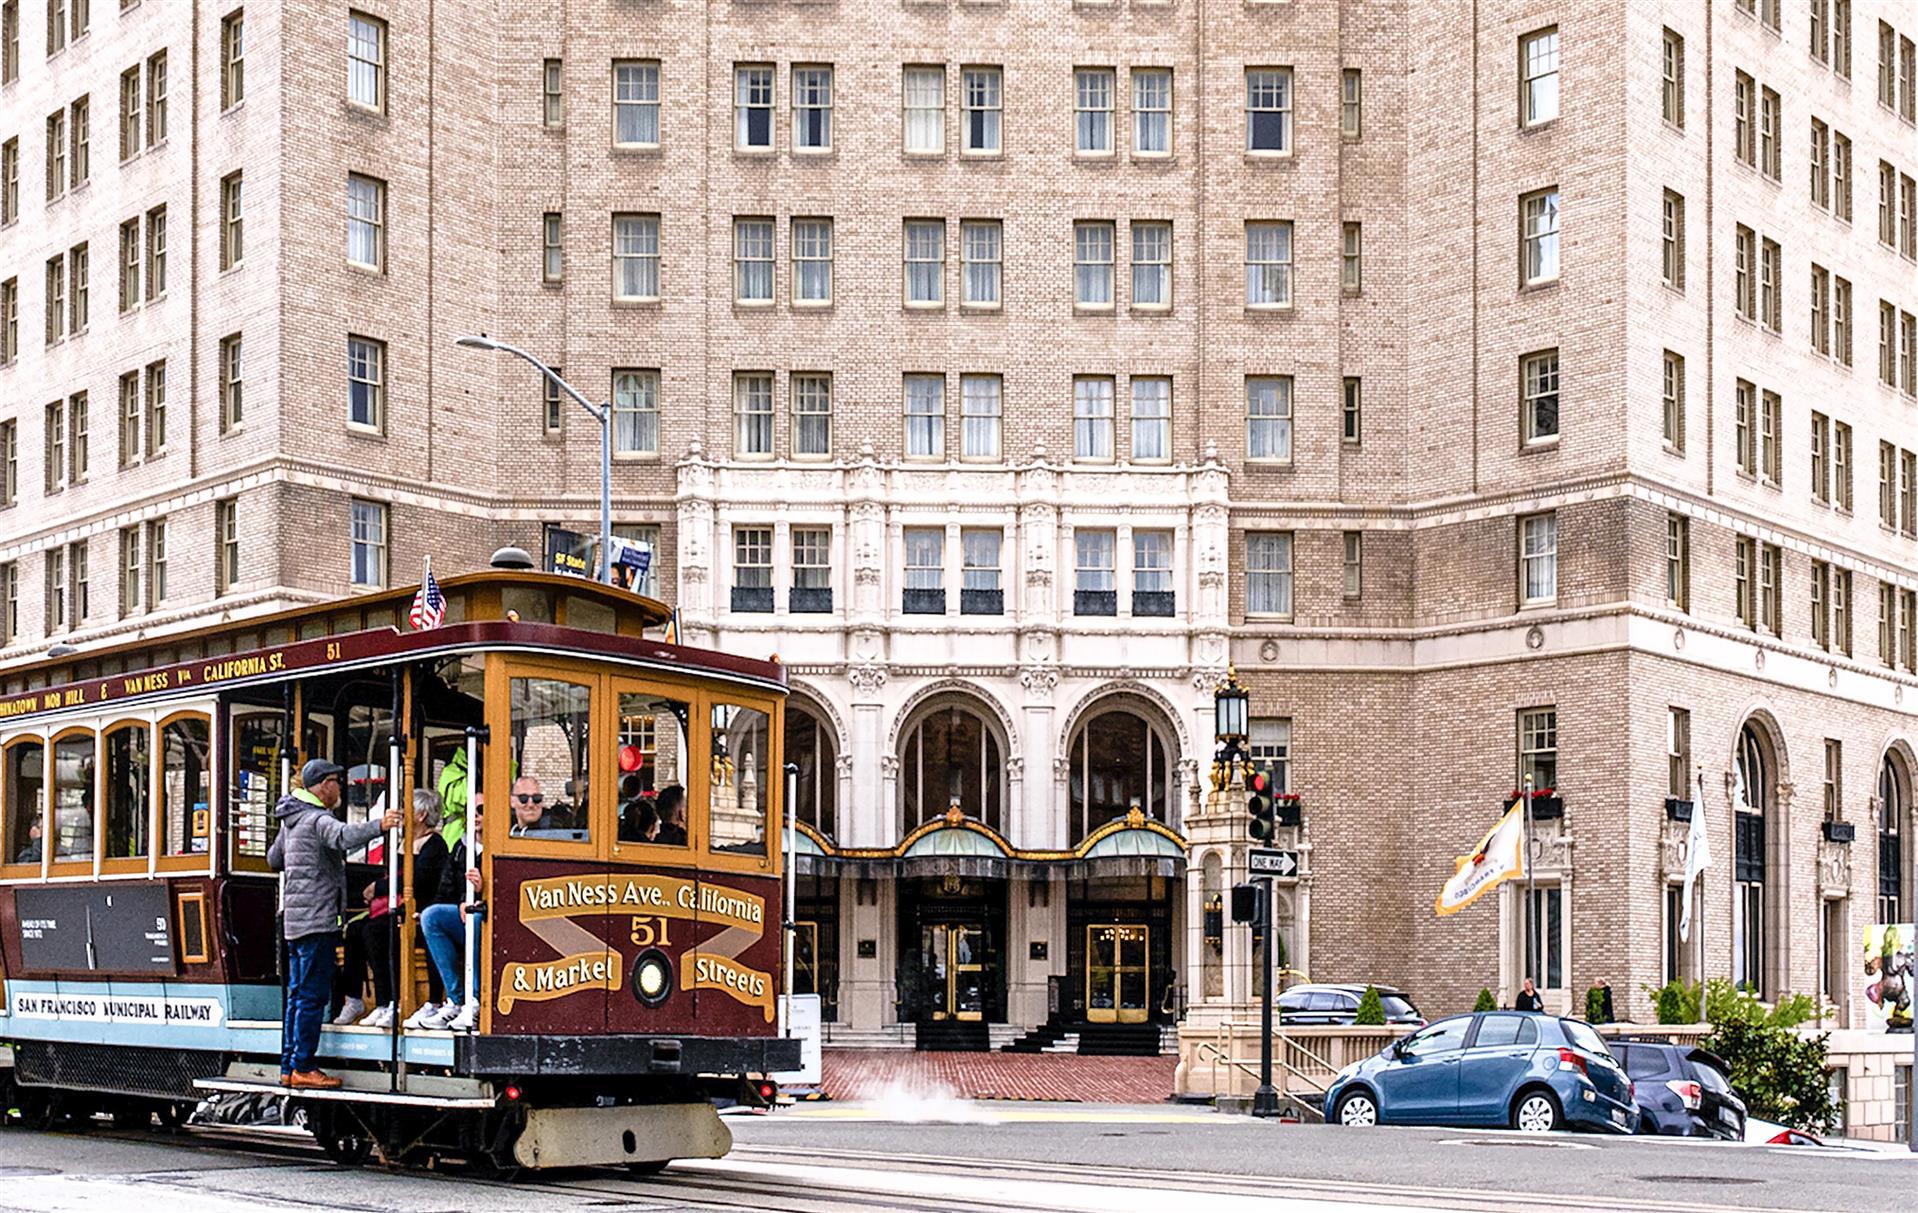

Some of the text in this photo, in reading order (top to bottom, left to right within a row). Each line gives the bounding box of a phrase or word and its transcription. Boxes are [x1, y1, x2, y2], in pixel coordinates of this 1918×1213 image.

[555, 552, 586, 570] SF State
[44, 692, 61, 709] NOB
[65, 688, 85, 706] HILL
[124, 678, 143, 694] VAN
[143, 672, 169, 692] NESS
[203, 657, 267, 682] CALIFORNIA
[269, 652, 286, 671] ST.
[326, 642, 342, 661] 51
[1254, 856, 1284, 869] ONE WAY
[525, 884, 565, 910] Van
[566, 880, 618, 907] Ness
[677, 885, 762, 924] California
[630, 916, 672, 947] 51
[513, 957, 613, 992] & Market
[696, 958, 765, 996] Streets
[18, 998, 211, 1021] SAN FRANCISCO MUNICIPAL RAILWAY
